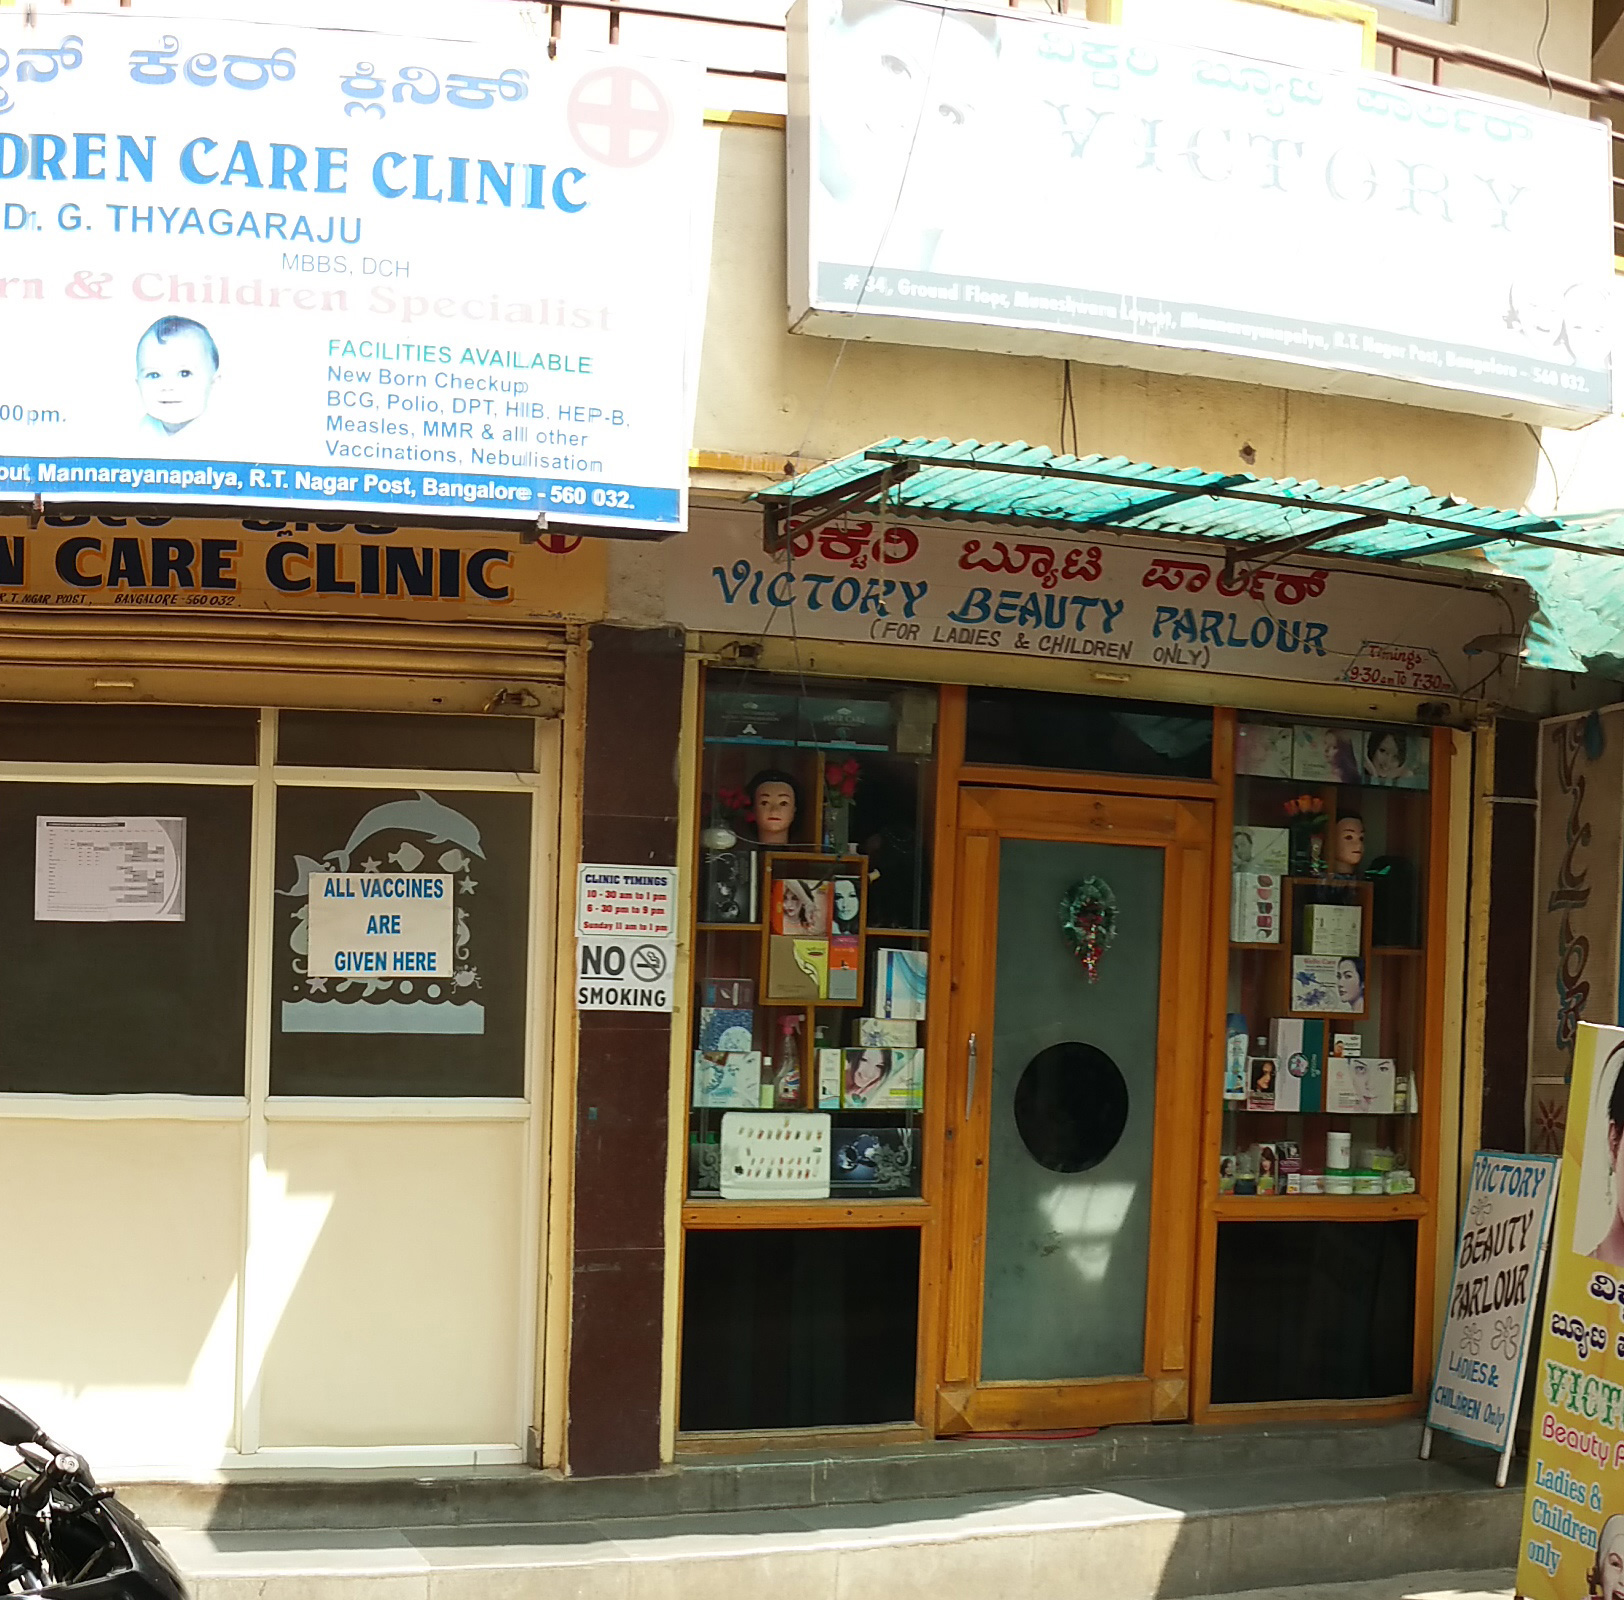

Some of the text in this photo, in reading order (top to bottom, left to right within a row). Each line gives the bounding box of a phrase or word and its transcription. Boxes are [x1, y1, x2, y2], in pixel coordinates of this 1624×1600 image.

[179, 135, 349, 195] CARE
[372, 151, 592, 214] CLINIC
[4, 203, 362, 244] Dr. G. THYAGARAJU
[282, 252, 410, 278] MBBS, DCH
[132, 272, 348, 312] Children
[369, 286, 614, 332] Specialist
[328, 339, 594, 375] FACILITIES AVAILABLE
[328, 365, 372, 384] New
[378, 367, 427, 388] Born
[327, 415, 589, 448] Measles, MMR other
[325, 440, 463, 465] Vaccinations,
[249, 469, 289, 489] R.T.
[294, 471, 359, 497] Nagar
[363, 474, 417, 500] Post,
[422, 476, 532, 506] Bangalore
[549, 485, 587, 505] 560
[54, 536, 238, 590] CARE
[264, 541, 514, 600] CLINIC
[712, 559, 1329, 658] VICTORY BEAUTY PARLOUR
[932, 624, 1002, 649] LADIES
[1038, 631, 1132, 661] CHILDREN
[324, 877, 444, 899] ALL VACCINES
[585, 874, 668, 886] CLINIC TIMINGS
[366, 914, 401, 935] ARE
[583, 921, 613, 931] Sunday
[334, 951, 437, 972] GIVEN HERE
[580, 945, 626, 976] NO
[578, 987, 666, 1007] SMOKING
[1474, 1156, 1546, 1200] VICTORY
[1460, 1208, 1535, 1270] BEAUTY
[1449, 1263, 1530, 1321] PARLOUR
[1434, 1385, 1481, 1419] CHILDREN
[1540, 1415, 1611, 1468] Beauty
[1534, 1459, 1603, 1512] Ladies &
[1530, 1498, 1599, 1551] Children
[1528, 1539, 1562, 1576] only
